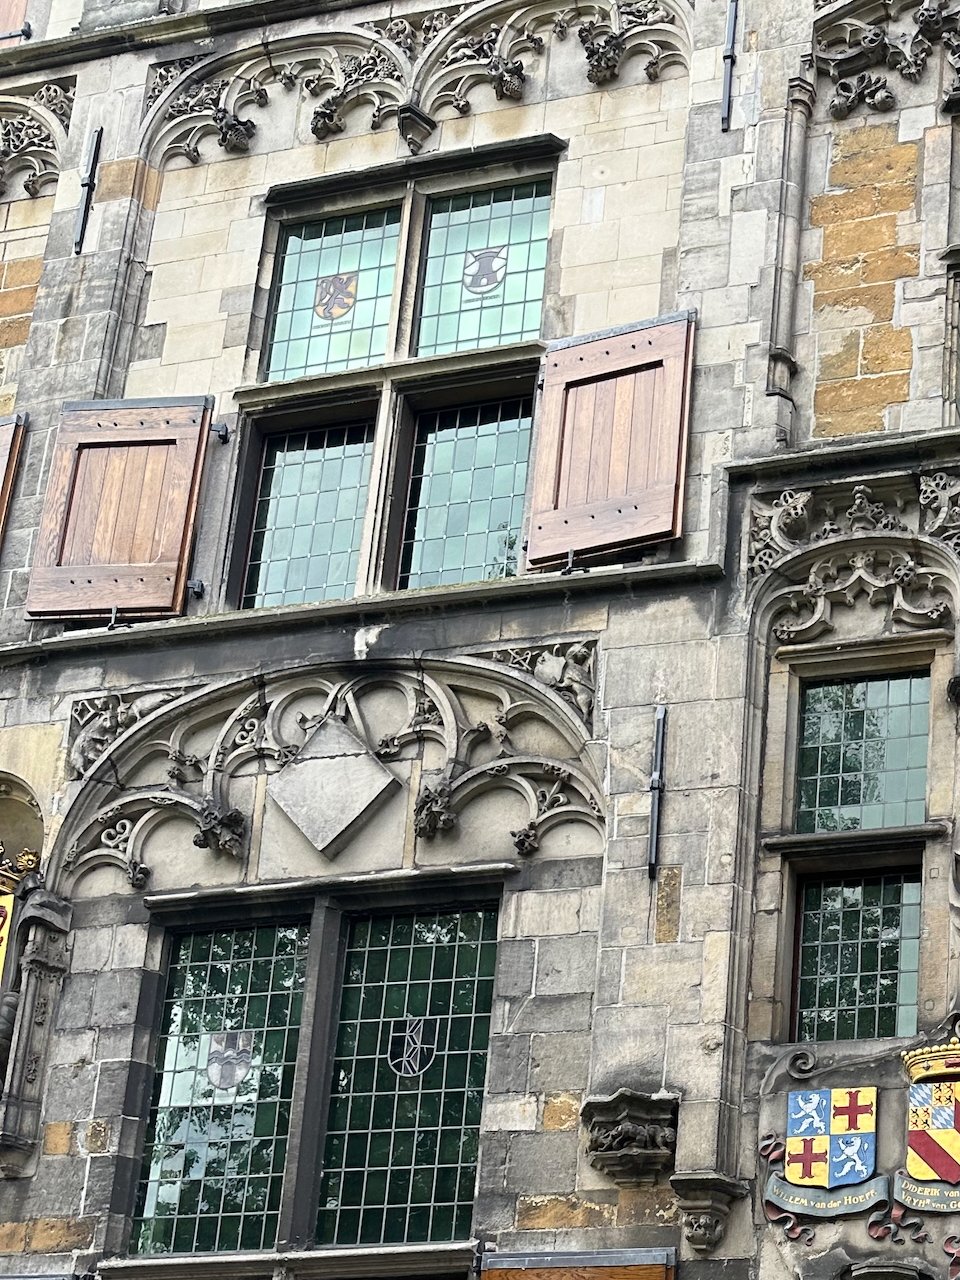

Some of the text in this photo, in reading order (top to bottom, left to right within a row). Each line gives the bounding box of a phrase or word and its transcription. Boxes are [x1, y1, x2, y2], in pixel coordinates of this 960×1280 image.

[772, 1184, 808, 1206] WILLEM
[810, 1201, 826, 1209] van
[826, 1199, 842, 1208] der
[901, 1180, 940, 1196] DIDERIK
[944, 1190, 960, 1198] van
[932, 1202, 947, 1210] van
